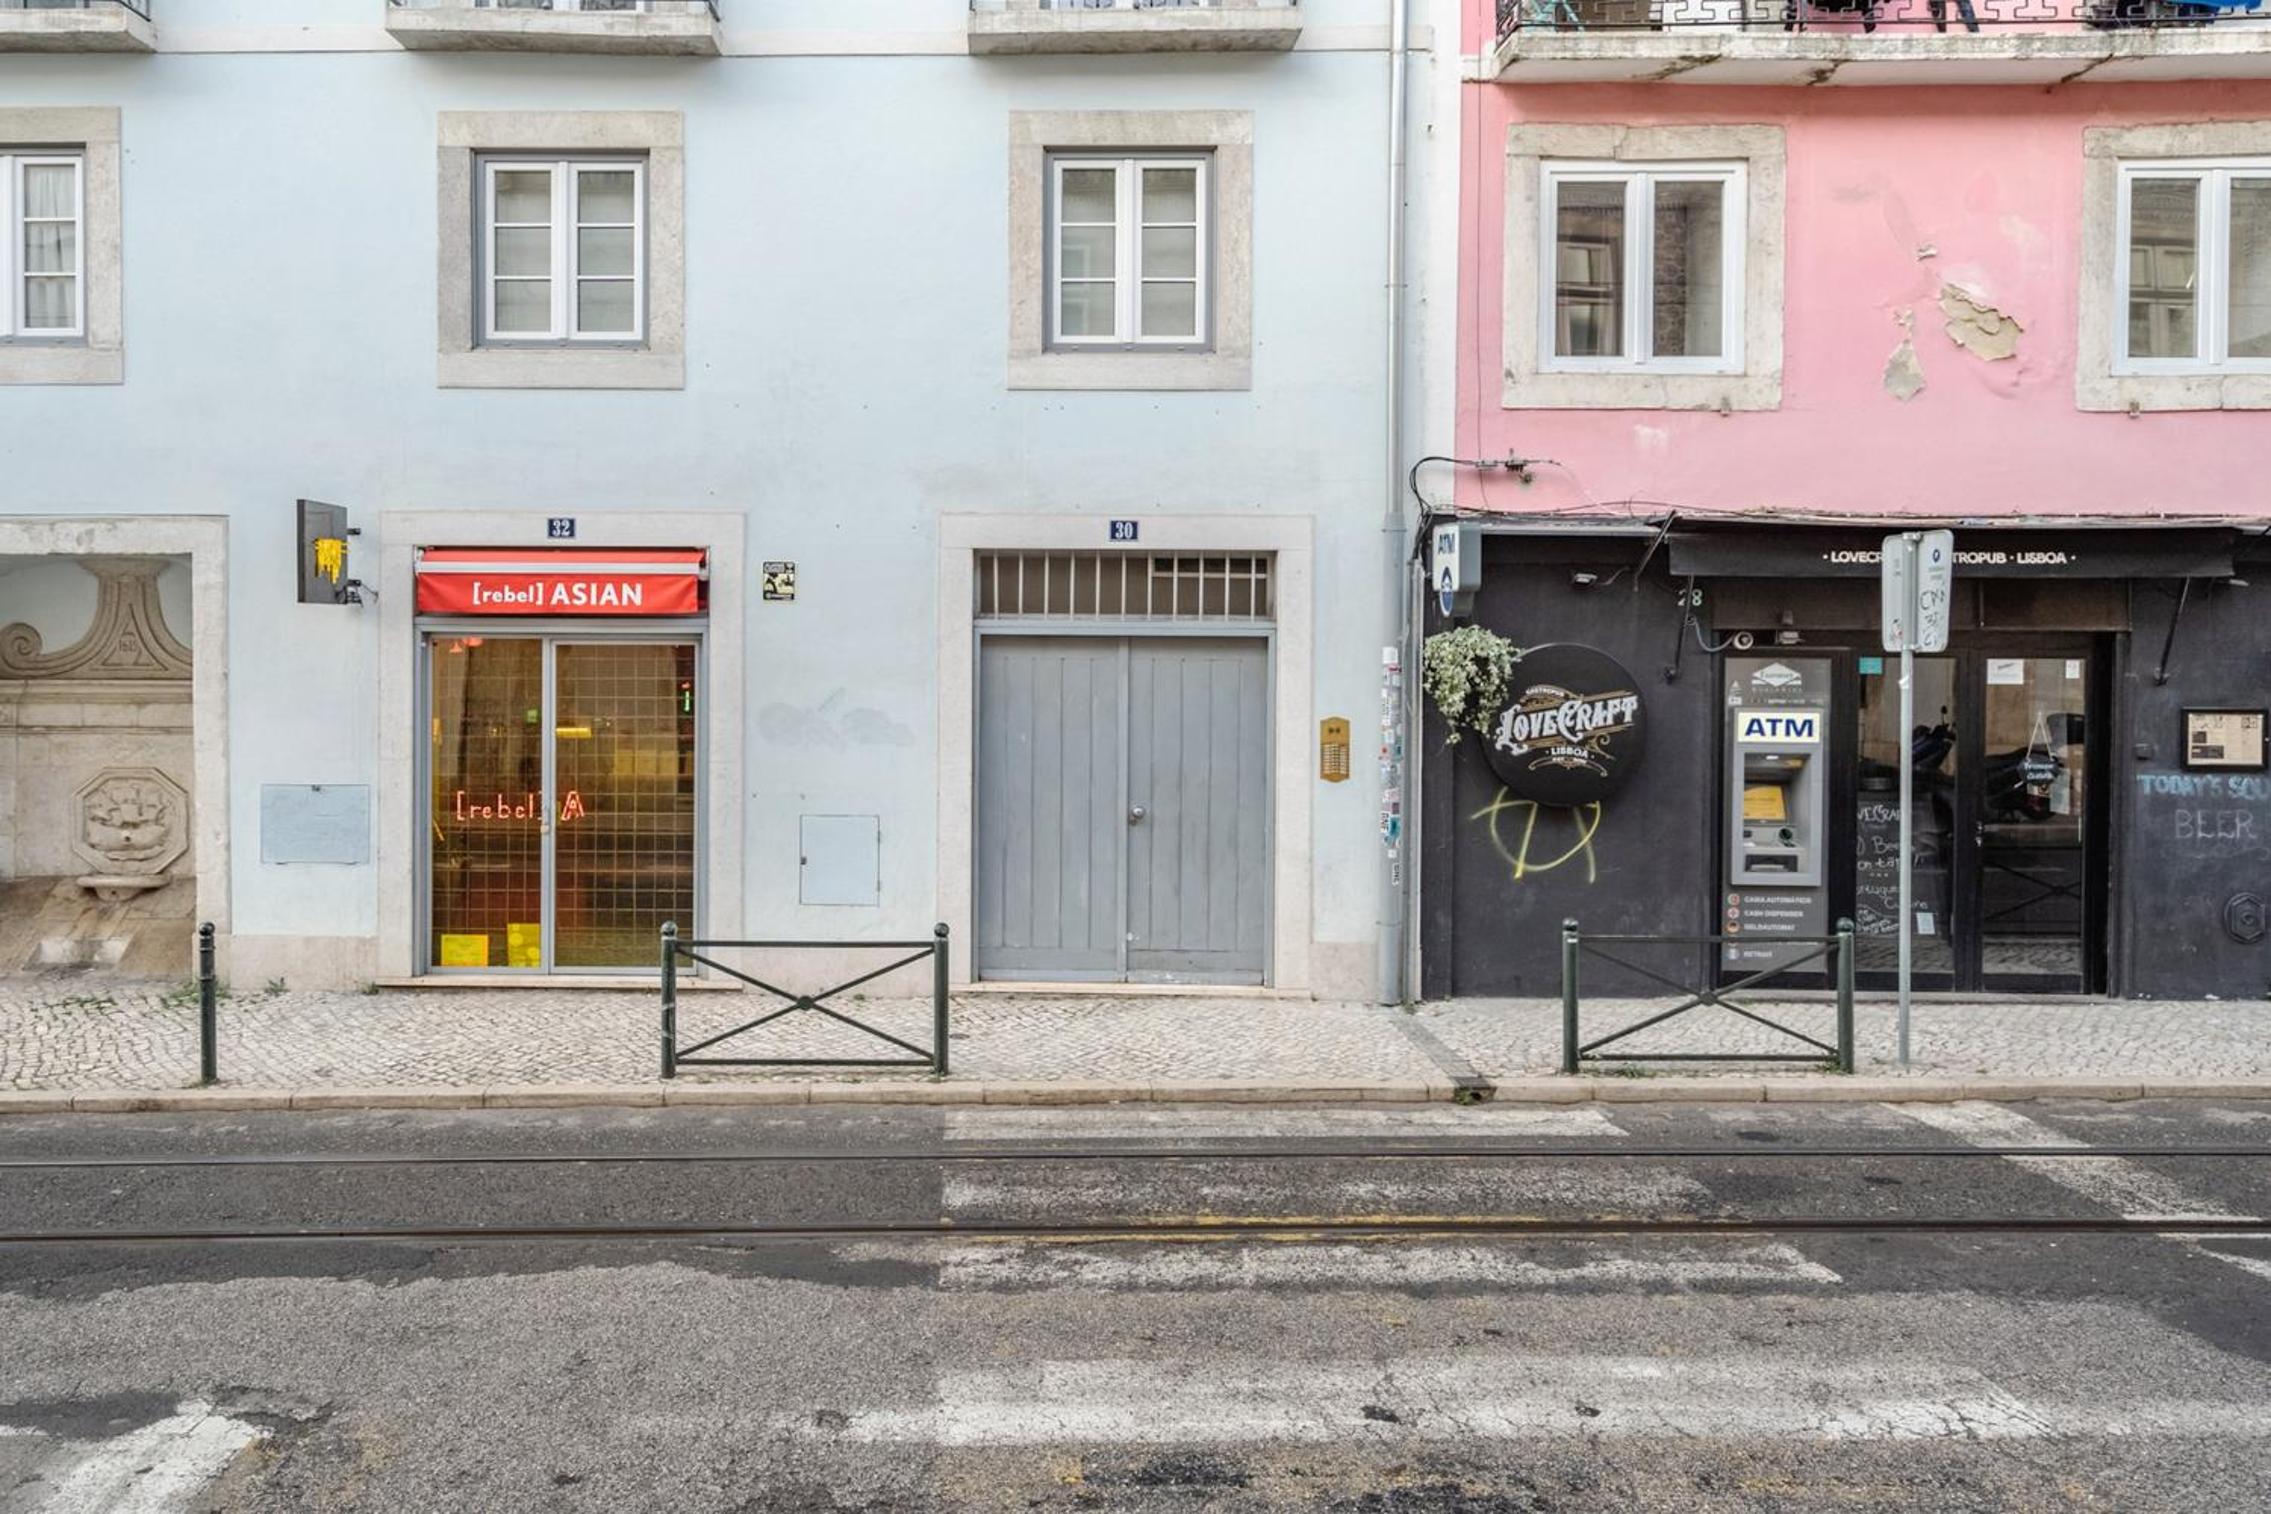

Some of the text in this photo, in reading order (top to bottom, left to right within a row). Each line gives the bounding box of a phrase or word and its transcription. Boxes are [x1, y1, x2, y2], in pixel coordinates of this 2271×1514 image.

[552, 520, 570, 536] 32
[1115, 521, 1134, 539] 30
[1952, 552, 2007, 564] TROPUB
[2016, 552, 2068, 564] LISBOA
[473, 582, 643, 606] [rebel] ASIAN
[1745, 717, 1814, 737] ATM
[1551, 746, 1589, 759] LISBOA
[2228, 774, 2271, 800] SOU
[2175, 808, 2257, 839] BEER
